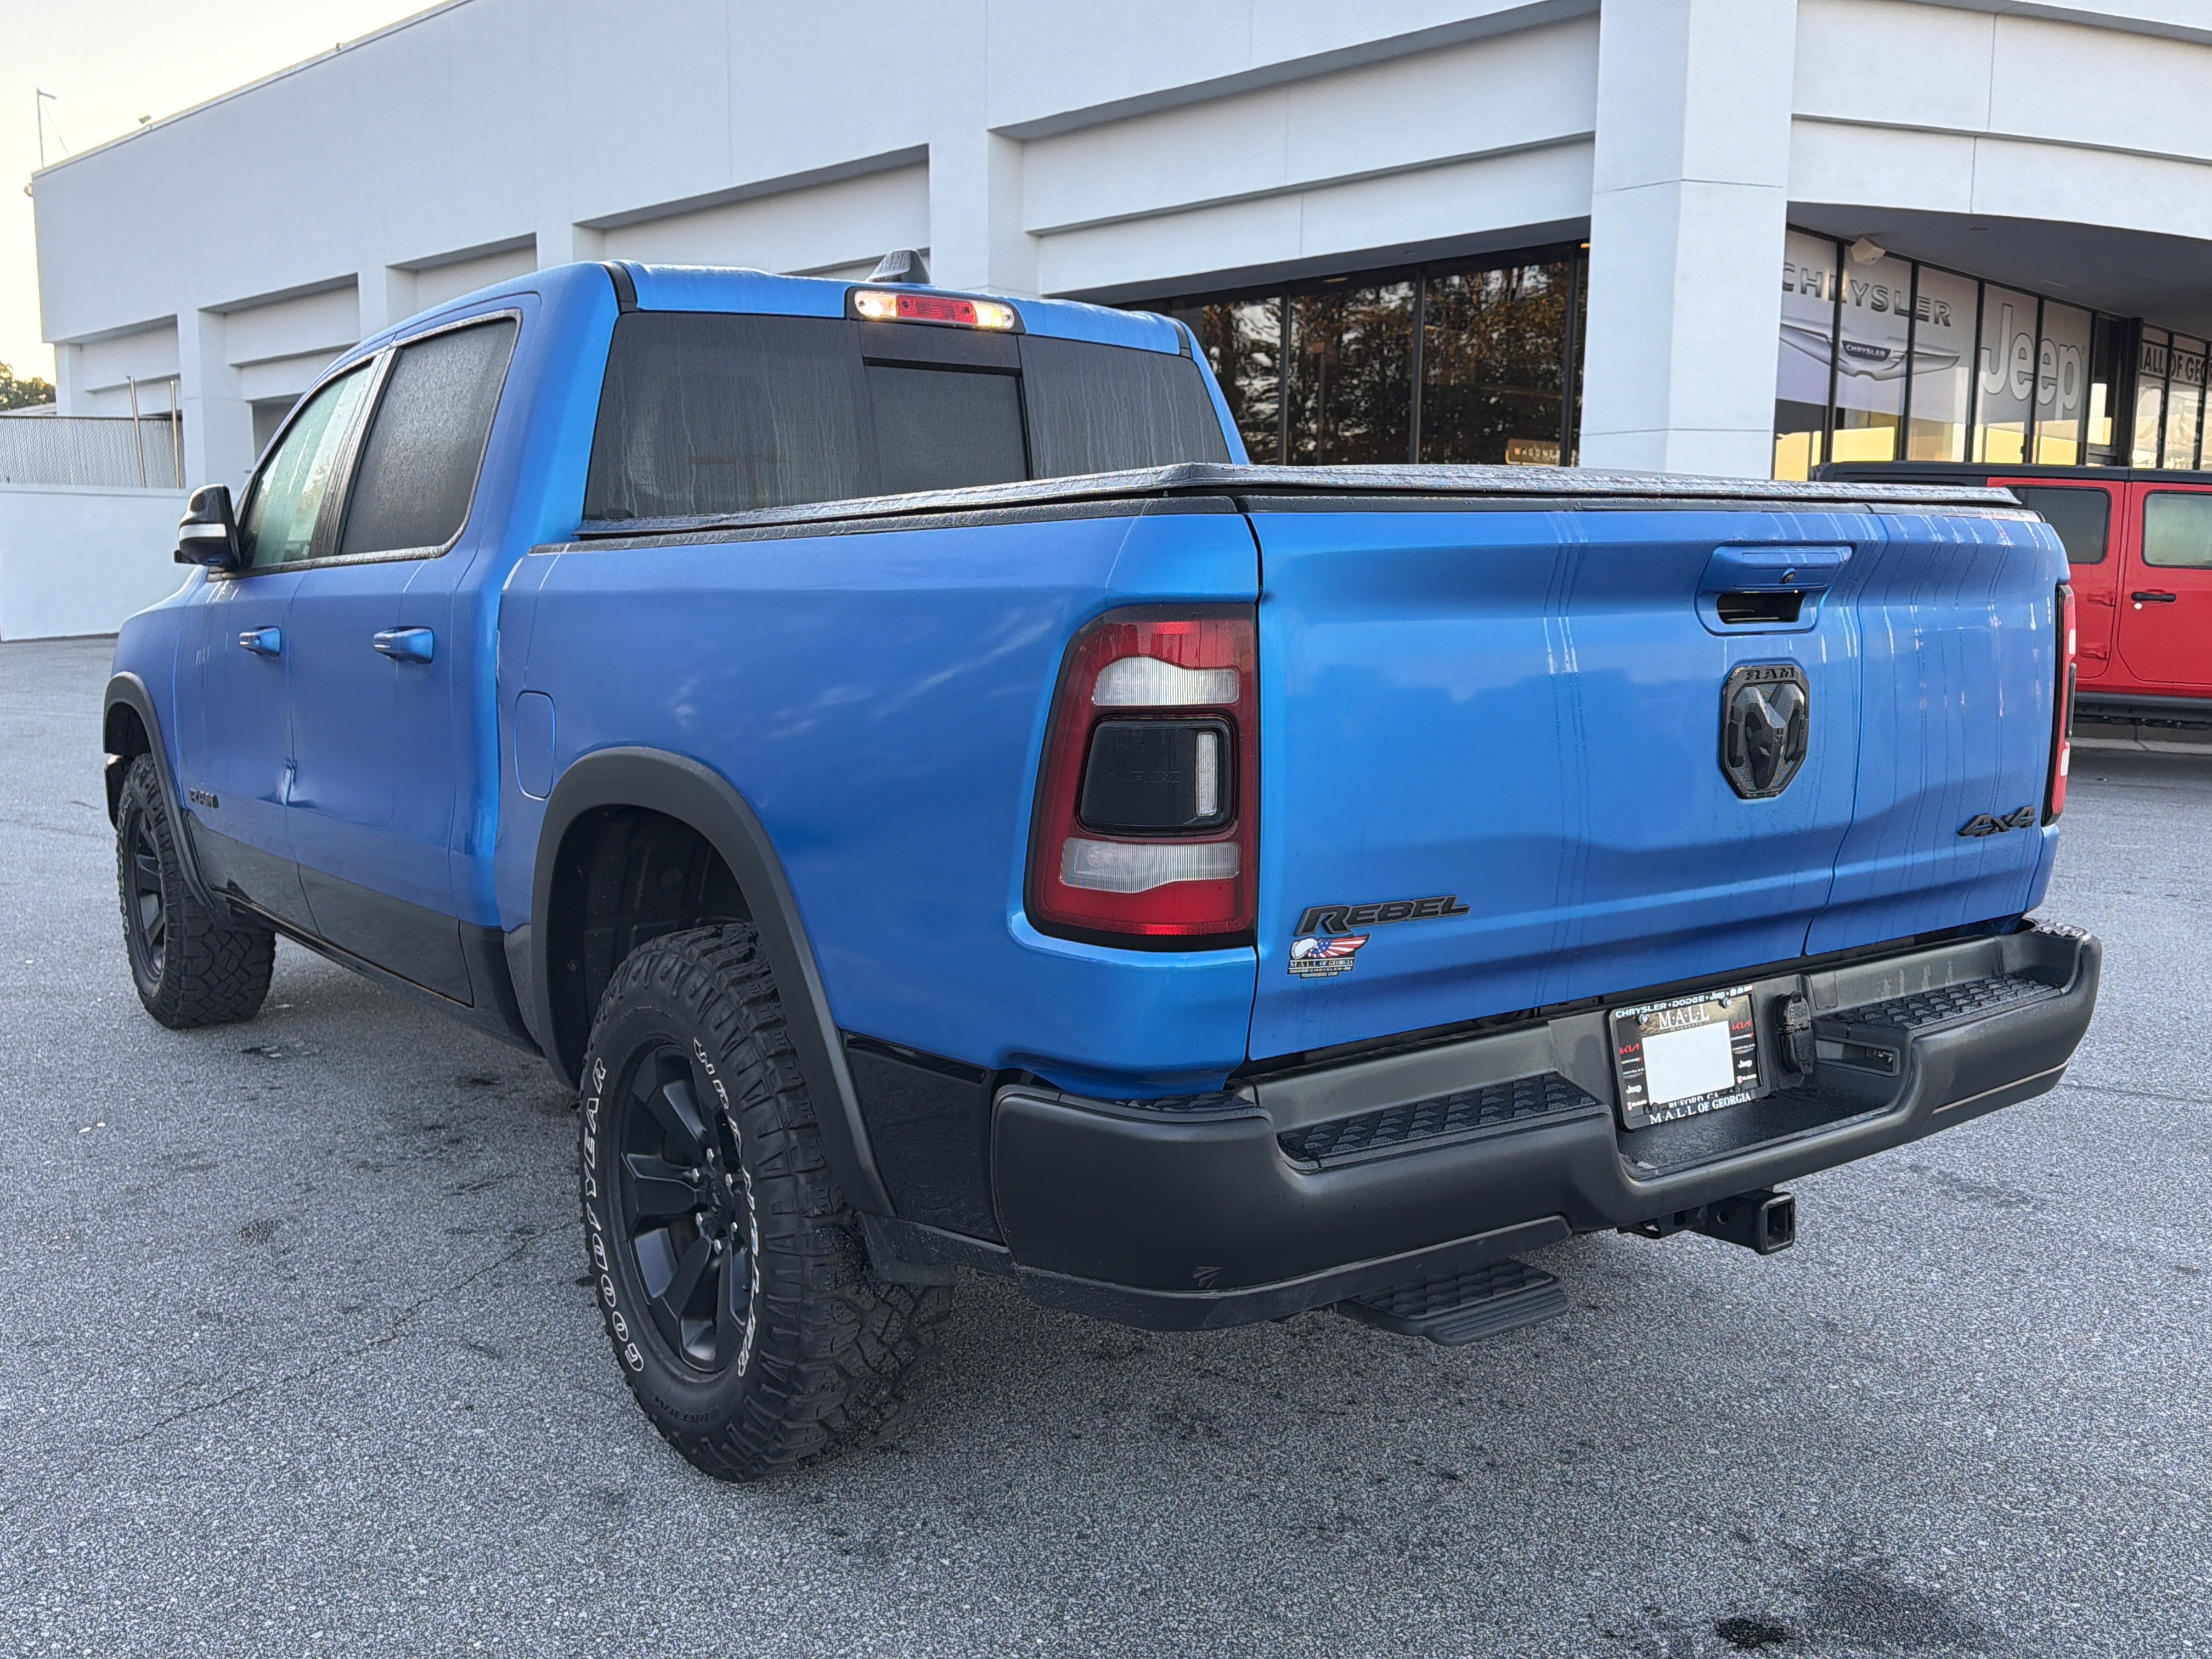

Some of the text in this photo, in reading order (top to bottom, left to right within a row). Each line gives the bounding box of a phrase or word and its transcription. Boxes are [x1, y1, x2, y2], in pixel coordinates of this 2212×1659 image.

[1846, 343, 1886, 357] CHRYSLER
[1981, 303, 2083, 409] Jeep
[2141, 347, 2164, 374] ALL
[1745, 667, 1796, 681] RAM
[1294, 894, 1471, 936] REBEL
[1615, 985, 1753, 1018] CHRYSLER DODGE Jeep RAM
[1737, 1059, 1753, 1069] Jeep
[1626, 1085, 1642, 1094] Jeep
[1697, 1101, 1710, 1113] OF
[1712, 1092, 1752, 1109] GEORGIA
[584, 1057, 644, 1372] GOODYEAR
